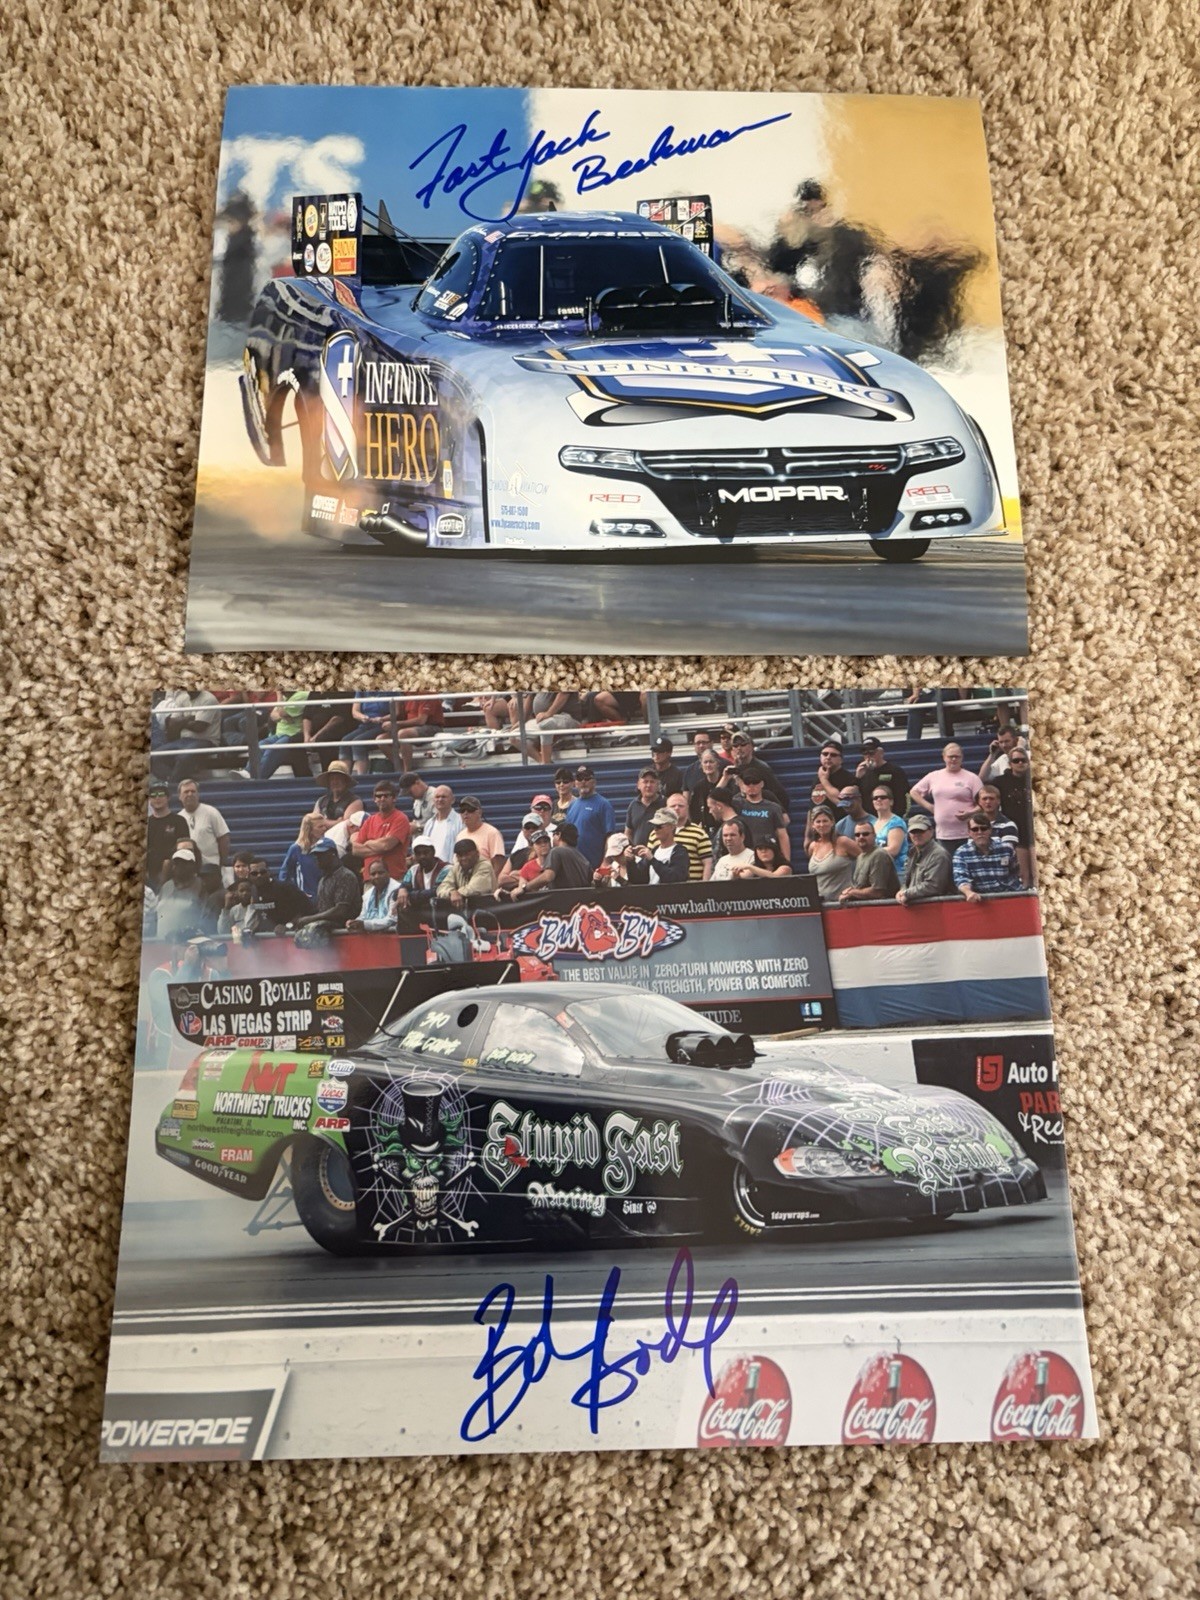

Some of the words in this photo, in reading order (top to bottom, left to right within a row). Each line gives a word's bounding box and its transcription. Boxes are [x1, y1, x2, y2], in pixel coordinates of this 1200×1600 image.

[364, 361, 439, 406] INFINITE
[541, 361, 754, 379] INFINITE
[770, 370, 897, 405] HERO
[363, 412, 440, 487] HERO
[718, 485, 848, 503] MOPAR
[906, 485, 951, 497] RED
[656, 895, 811, 915] www.badboymowers.com
[537, 915, 579, 960] Bad
[615, 910, 659, 959] Boy
[563, 968, 582, 982] THE
[583, 967, 605, 981] BEST
[607, 965, 639, 980] VALUE
[639, 965, 650, 979] IN
[655, 962, 709, 978] ZERO-TURN
[710, 959, 754, 975] MOWERS
[755, 958, 782, 973] WITH
[782, 957, 809, 971] ZERO
[201, 982, 253, 1010] CASINO
[259, 979, 312, 1007] ROYALE
[652, 977, 706, 994] STRENGTH,
[708, 976, 744, 992] POWER
[745, 976, 759, 990] OR
[760, 973, 811, 989] COMFORT.
[202, 1013, 226, 1036] LAS
[230, 1011, 273, 1035] VEGAS
[276, 1009, 313, 1033] STRIP
[204, 1035, 237, 1047] ARP
[238, 1036, 264, 1048] COMP
[328, 1036, 345, 1047] PJ1
[1007, 1061, 1048, 1084] Auto
[213, 1092, 271, 1115] NORTHWEST
[272, 1095, 312, 1118] TRUCKS
[315, 1117, 349, 1129] ARP
[220, 1149, 253, 1162] FRAM
[483, 1100, 600, 1190] Stupid
[603, 1110, 684, 1196] Fast
[700, 1397, 790, 1440] Coca-Cola
[844, 1397, 934, 1440] Coca-Cola
[993, 1393, 1081, 1438] Coca-Cola
[101, 1416, 253, 1447] POWERADE
